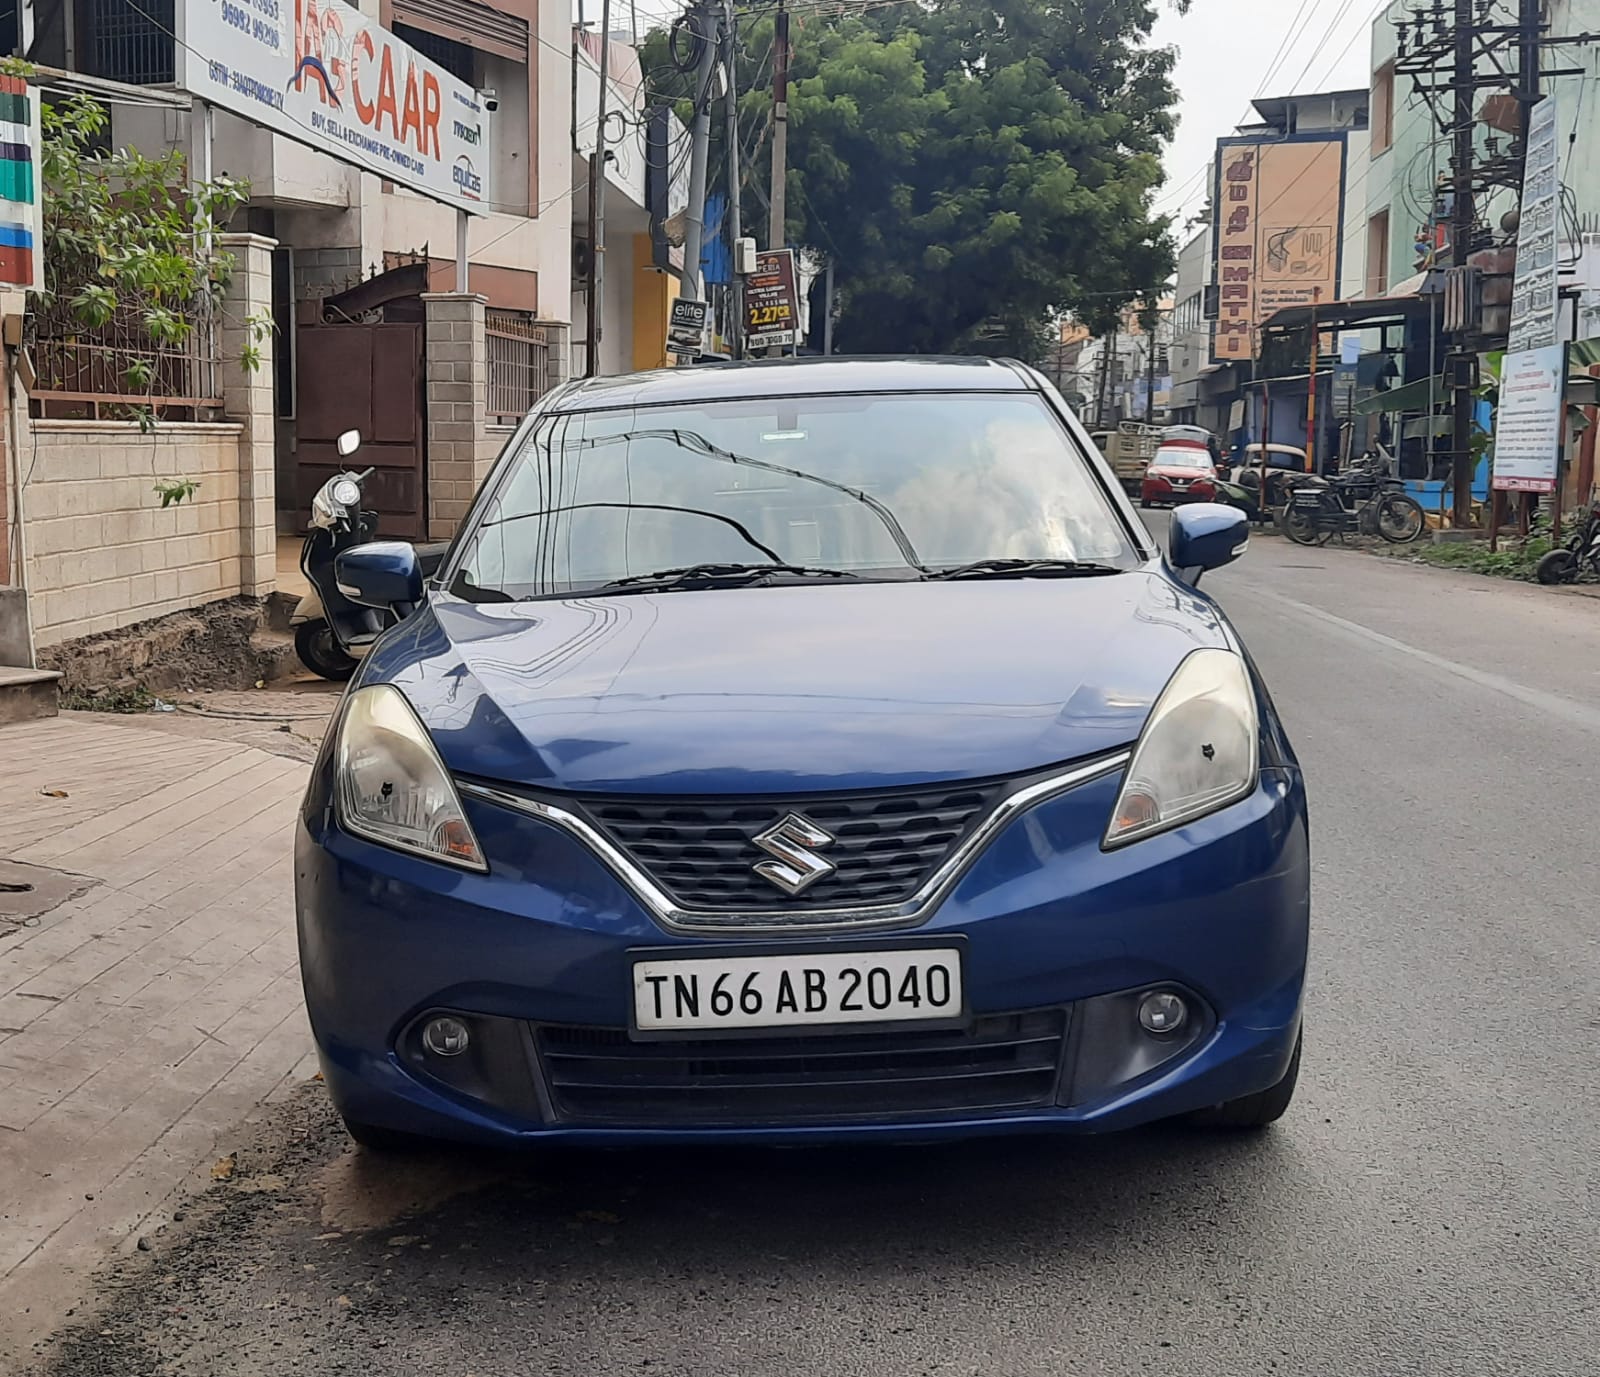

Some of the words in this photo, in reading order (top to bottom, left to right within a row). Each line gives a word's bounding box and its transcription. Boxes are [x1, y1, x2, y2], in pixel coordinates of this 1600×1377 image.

[351, 29, 441, 162] CAAR
[327, 118, 342, 140] SELL
[348, 127, 379, 155] EXCHANGE
[675, 303, 704, 319] elite
